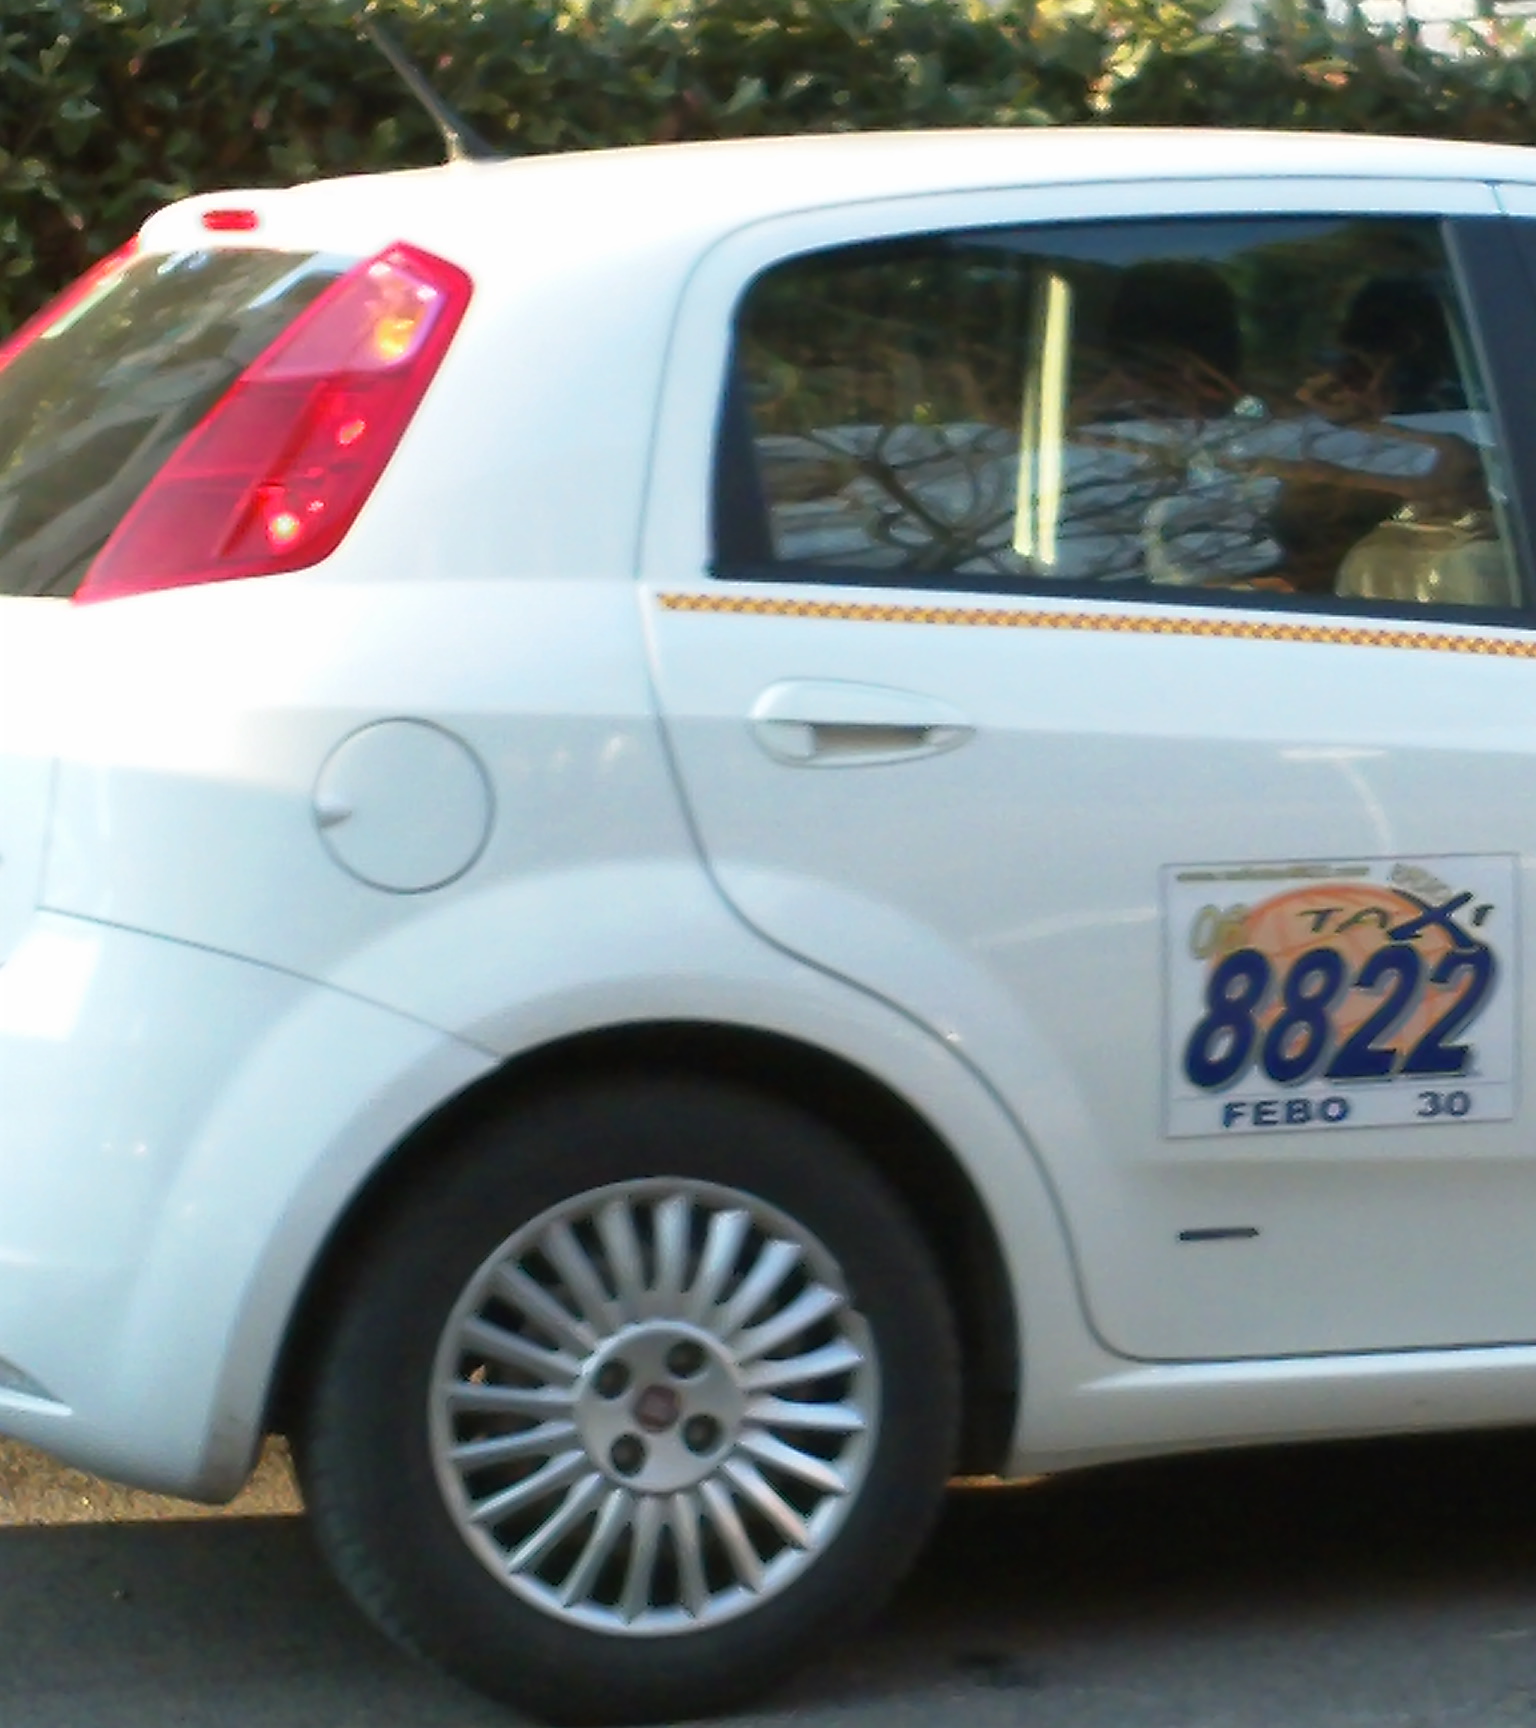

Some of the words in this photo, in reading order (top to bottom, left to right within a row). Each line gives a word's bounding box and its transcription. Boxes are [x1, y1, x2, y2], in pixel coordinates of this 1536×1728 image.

[1184, 944, 1497, 1091] 8822
[1222, 1097, 1349, 1128] FEBO
[1416, 1090, 1472, 1118] 30
